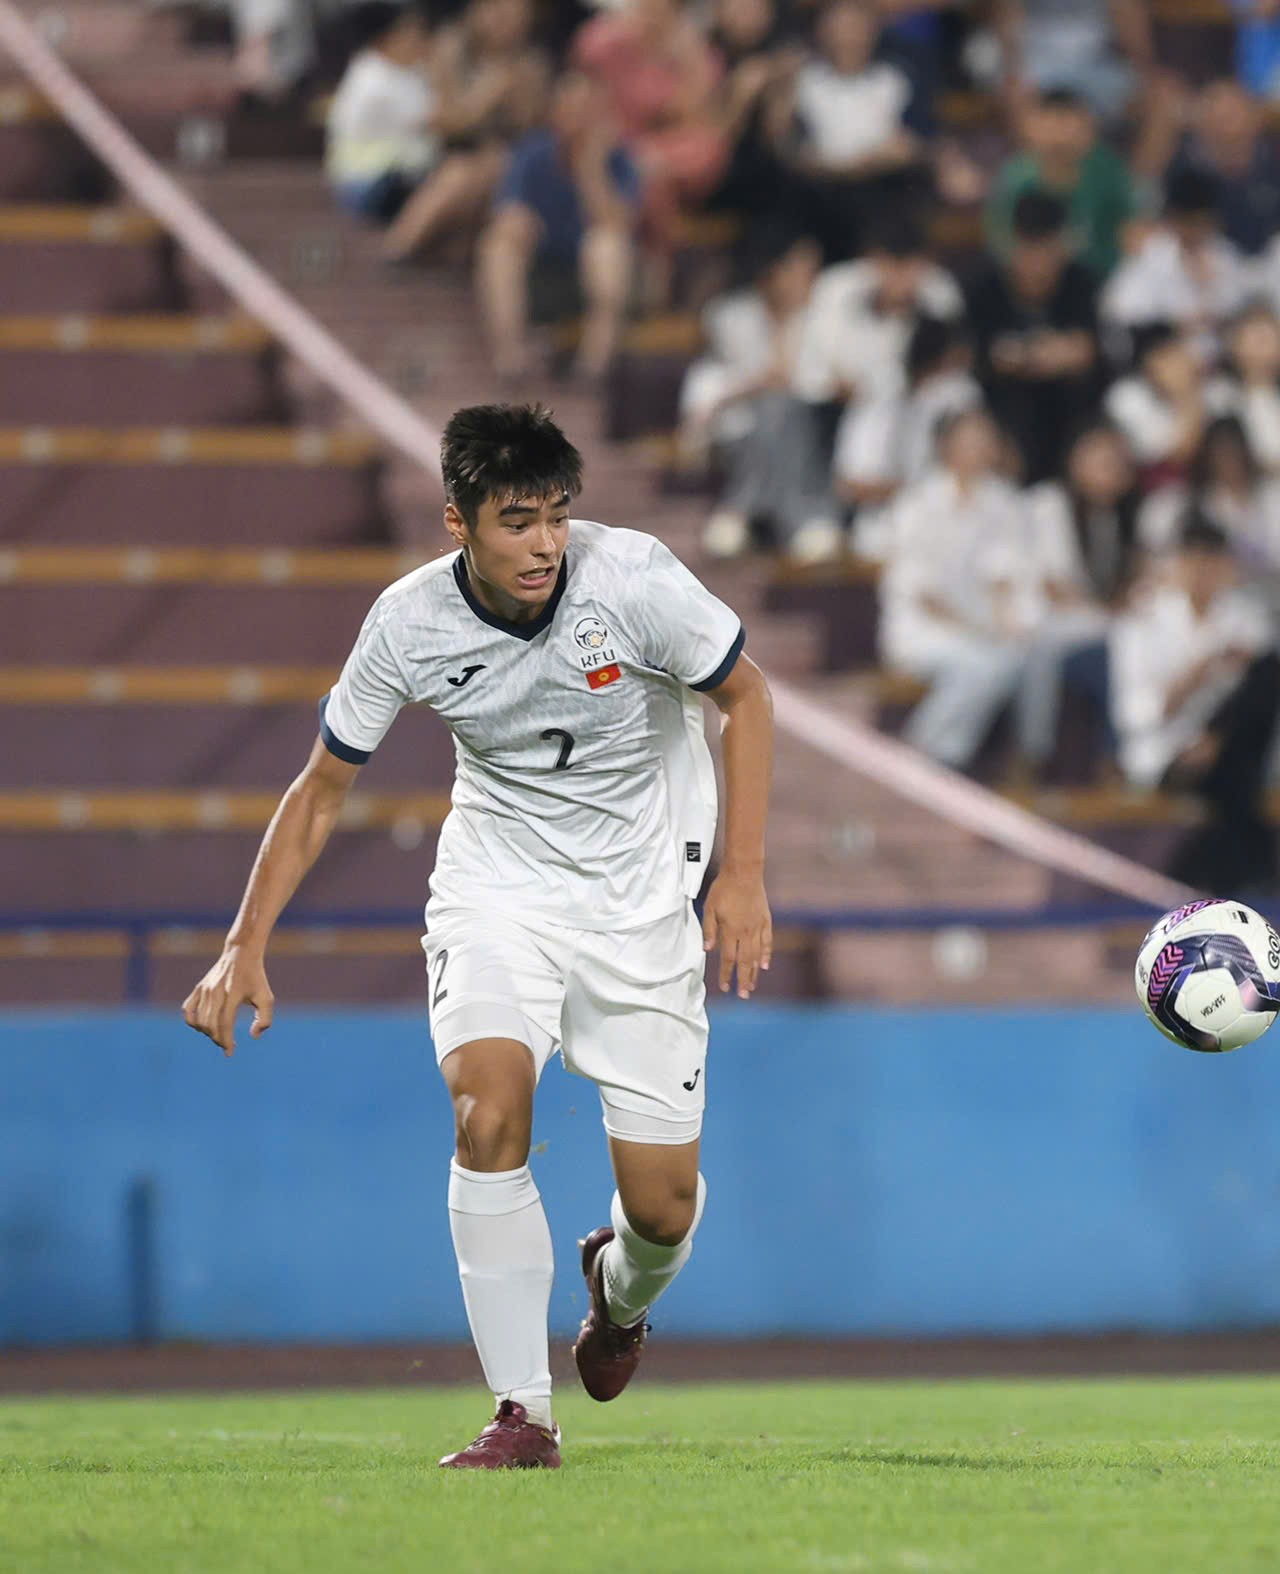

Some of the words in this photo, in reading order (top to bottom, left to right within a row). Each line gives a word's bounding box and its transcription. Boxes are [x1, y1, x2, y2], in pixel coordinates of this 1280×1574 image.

[580, 648, 616, 668] KFU
[540, 728, 576, 769] 2
[432, 948, 449, 1010] 2
